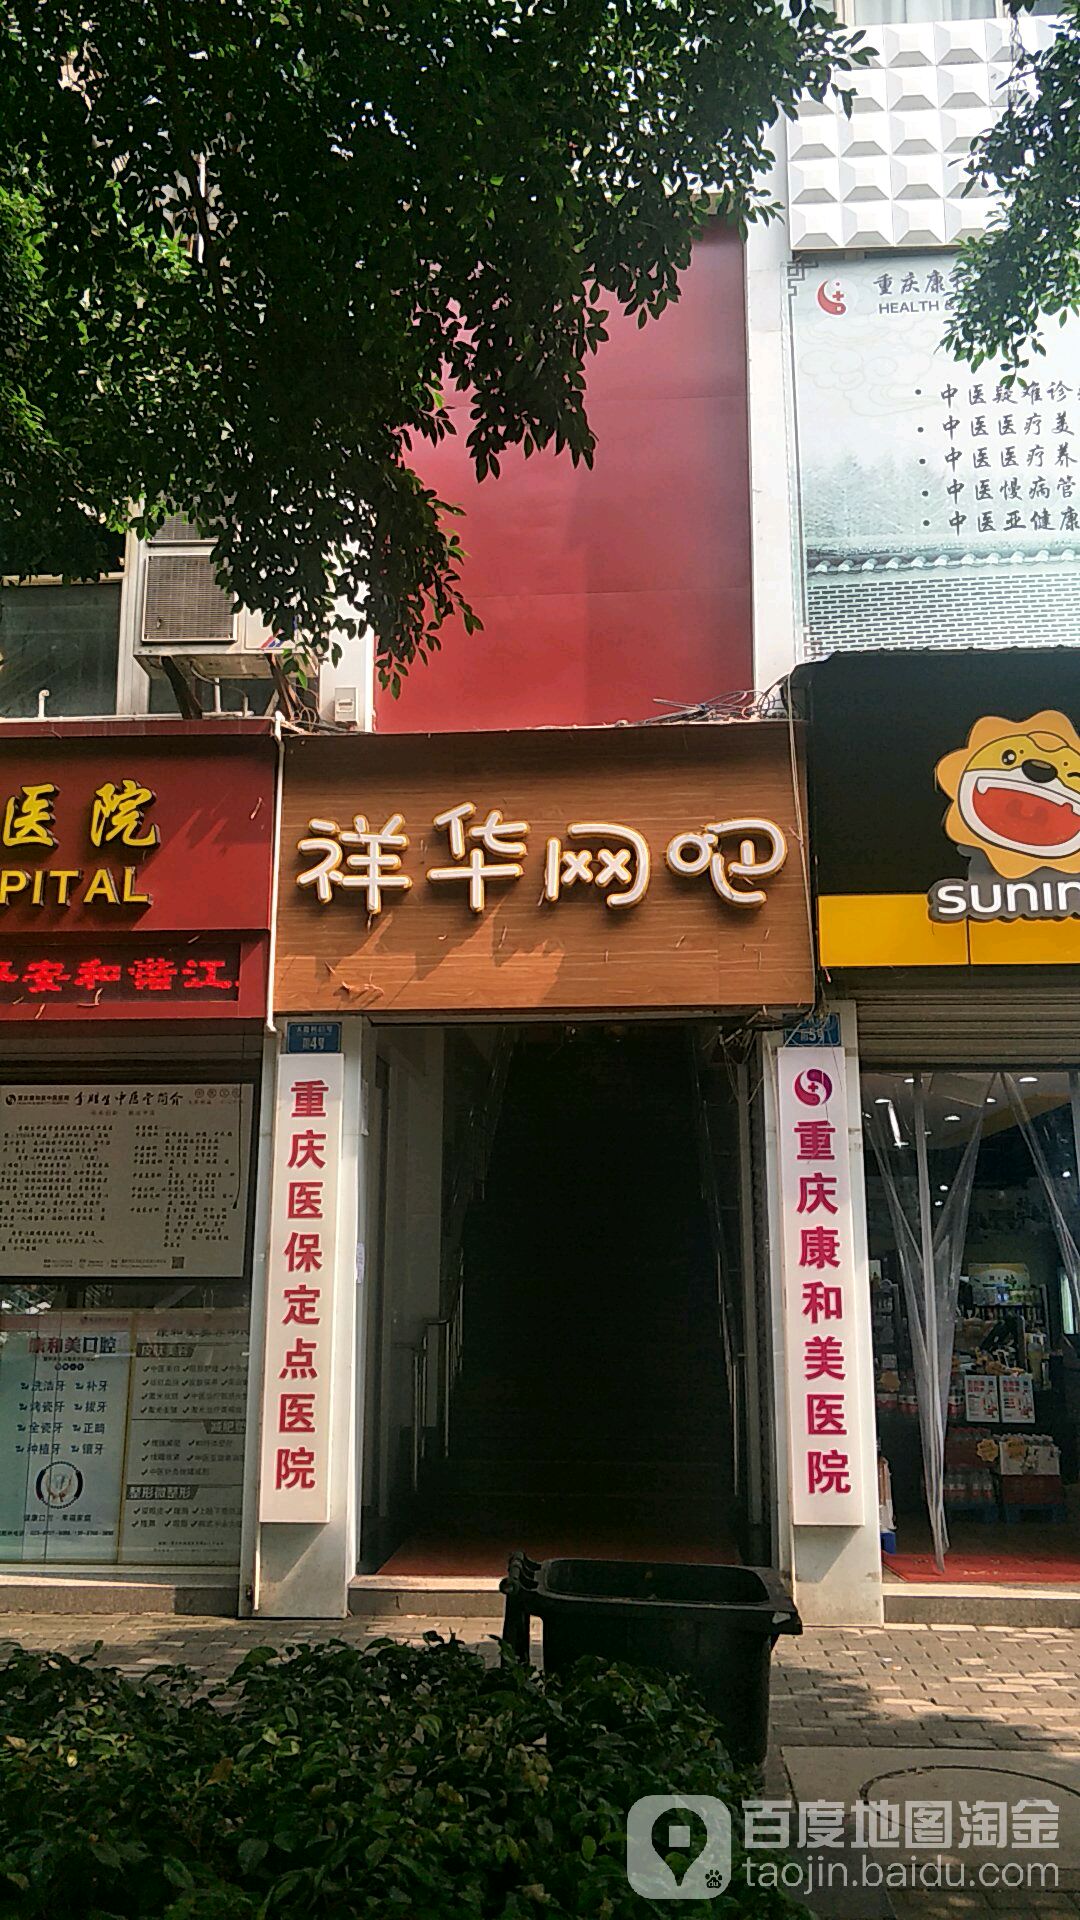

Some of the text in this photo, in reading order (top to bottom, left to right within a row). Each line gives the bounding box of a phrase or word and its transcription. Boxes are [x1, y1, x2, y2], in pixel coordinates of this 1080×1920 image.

[879, 301, 939, 314] HEALTH
[940, 381, 1080, 408] 中医疑难诊
[942, 412, 1075, 440] 中医医疗美
[944, 443, 1078, 472] 中医医疗养
[946, 475, 1077, 504] 中医慢病管
[949, 506, 1080, 536] 中医亚健康
[3, 779, 160, 847] 医院
[296, 802, 787, 914] 祥华网吧
[0, 866, 152, 906] PITAL
[274, 1079, 330, 1491] 重庆医保定点医院
[793, 1120, 852, 1495] 重庆康和美医院
[29, 1337, 116, 1353] 康和美口腔
[87, 1380, 108, 1391] 补牙
[85, 1401, 107, 1412] 拔牙
[27, 1444, 61, 1455] 种植牙
